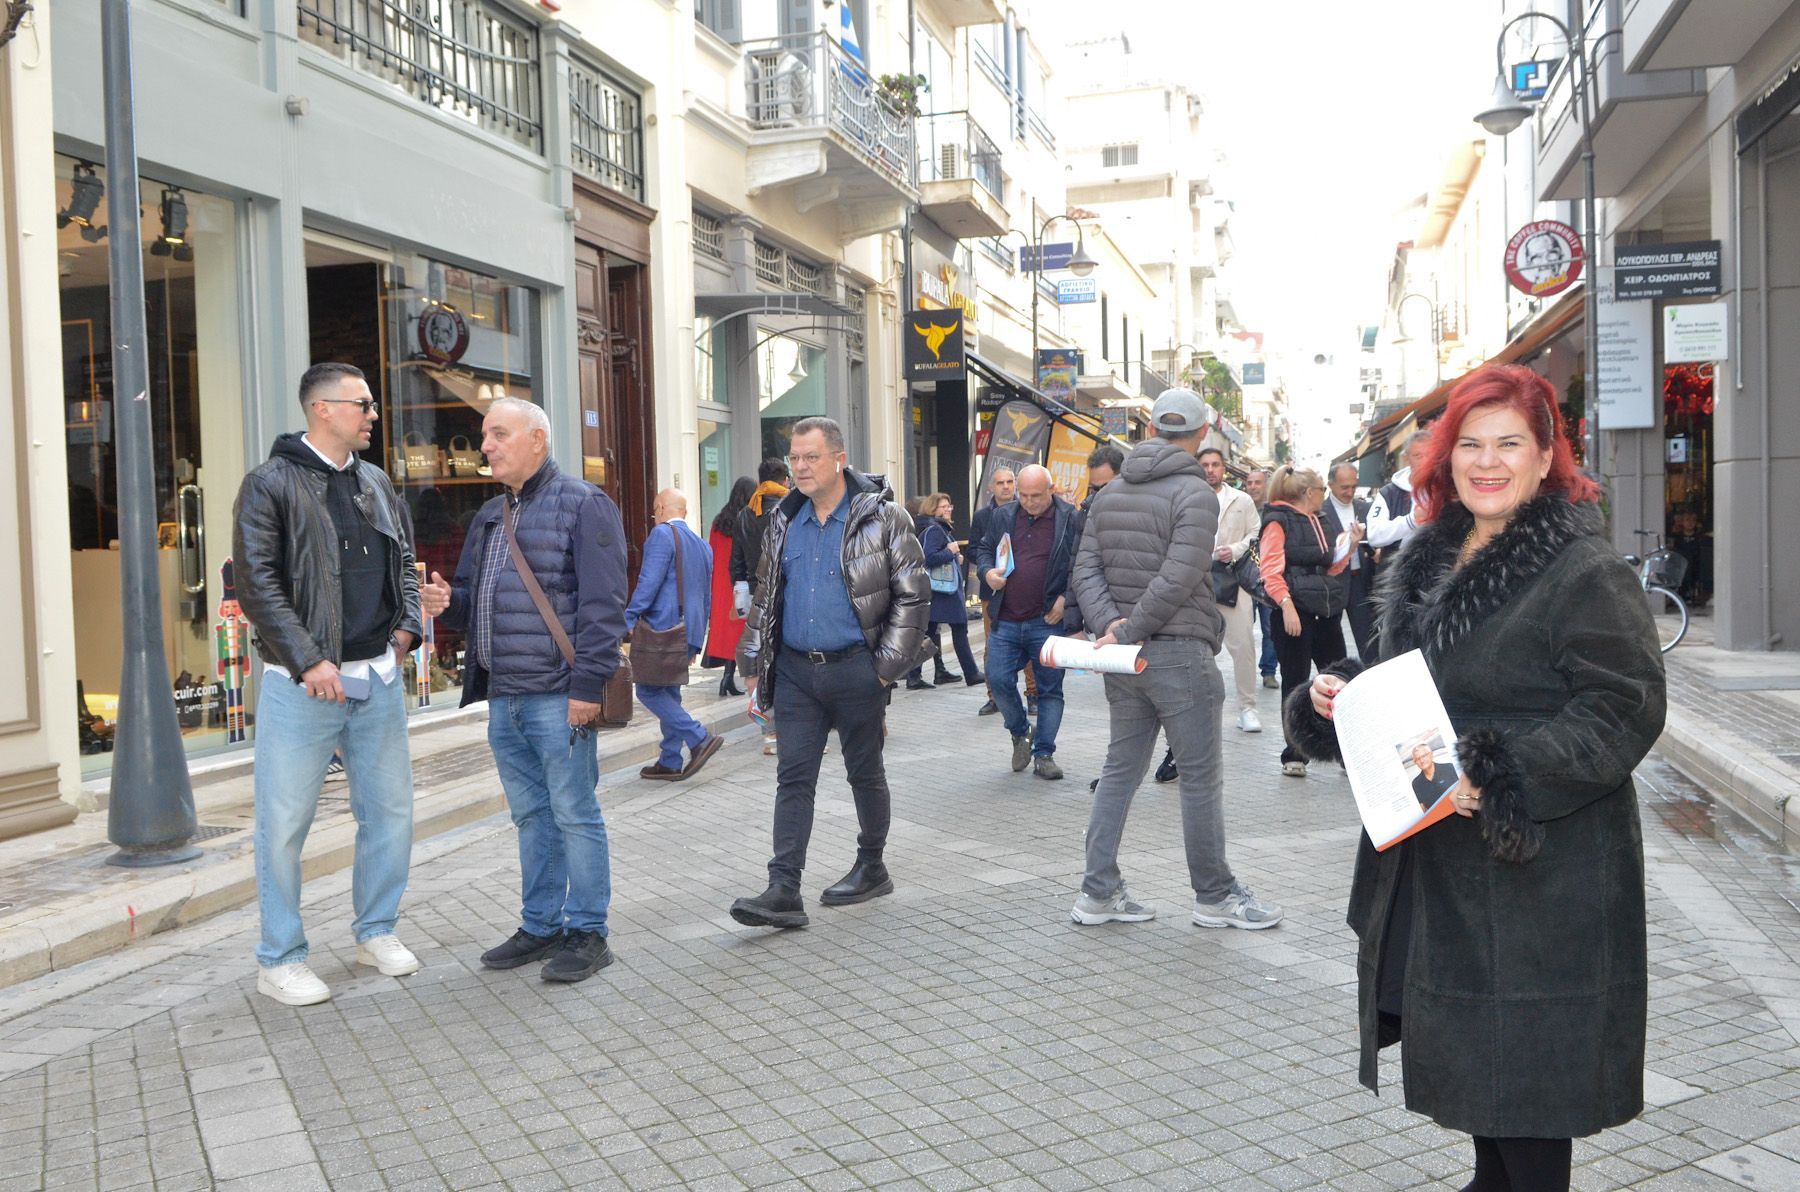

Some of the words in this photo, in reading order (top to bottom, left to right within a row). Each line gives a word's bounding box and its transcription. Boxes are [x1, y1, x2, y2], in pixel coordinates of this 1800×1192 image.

[1538, 222, 1580, 249] COMMUNITY
[1616, 253, 1670, 266] ΛΟΥΚΟΠΟΥΛΟΣ
[1686, 251, 1719, 261] ΑΝΔΡΕΑΣ
[1624, 275, 1646, 285] ΧΕΙΡ.
[1647, 271, 1712, 284] ΟΔΟΝΤΙΑΤΡΟΣ
[1373, 506, 1382, 518] 3
